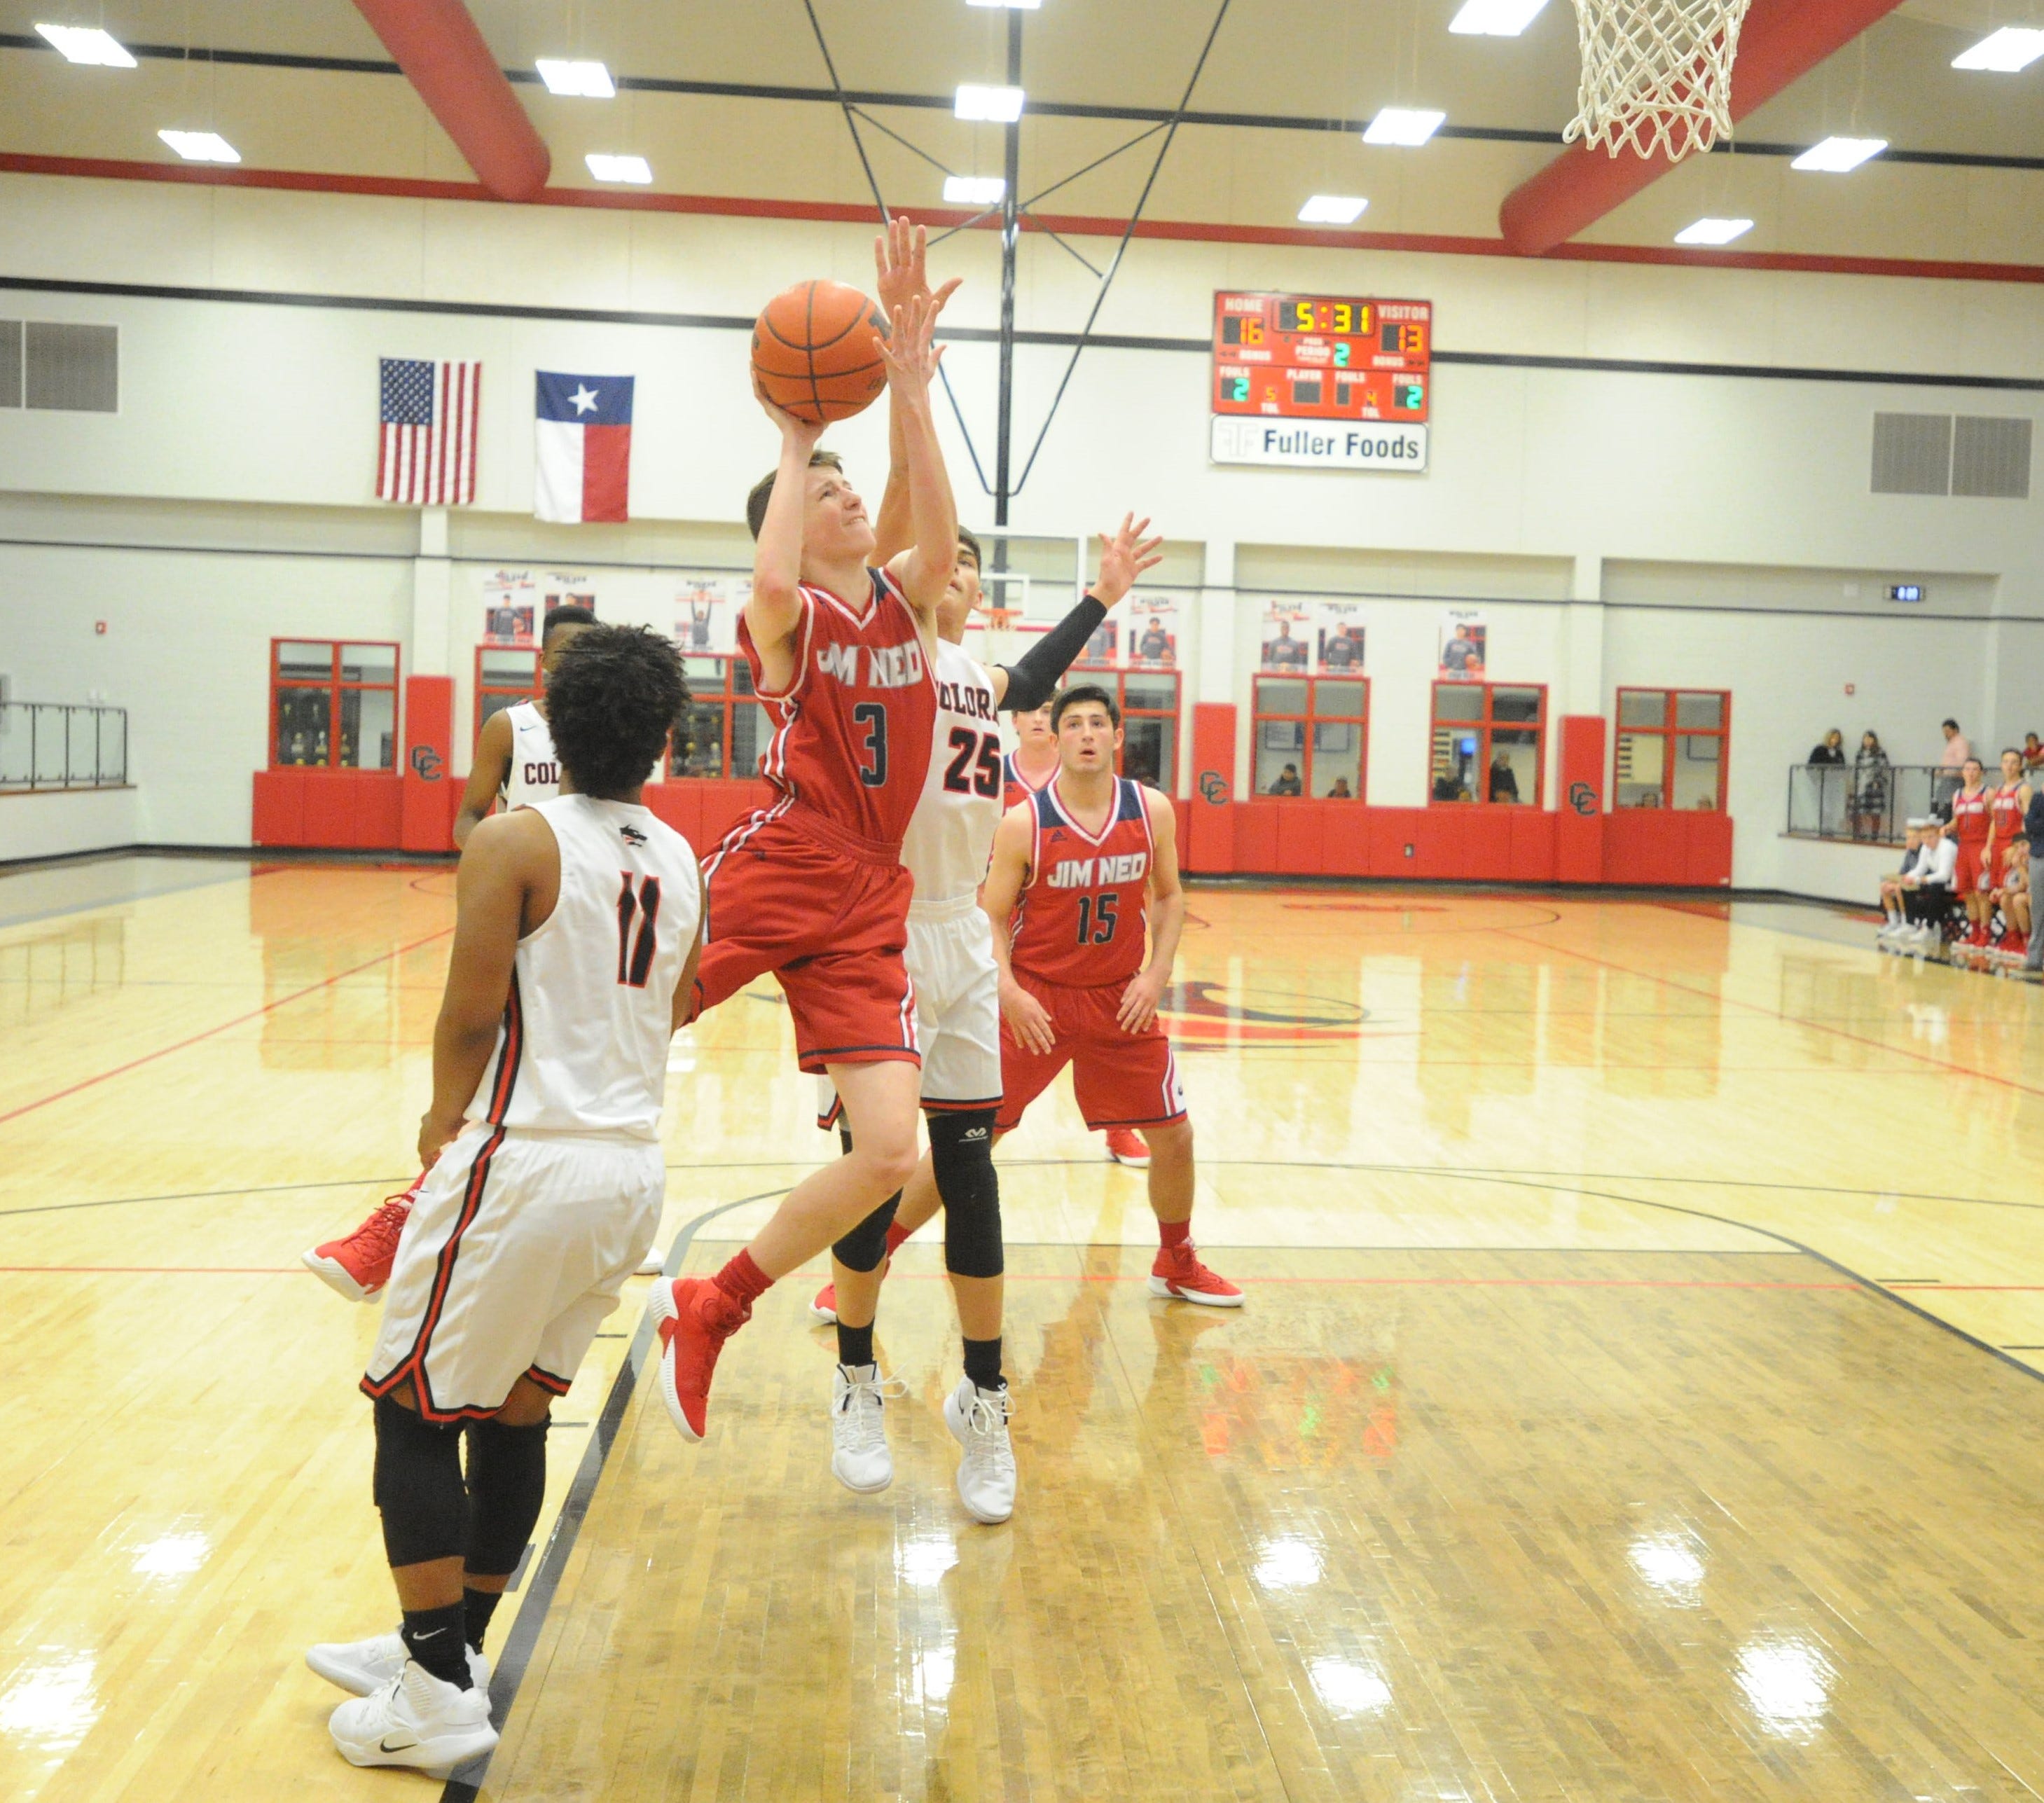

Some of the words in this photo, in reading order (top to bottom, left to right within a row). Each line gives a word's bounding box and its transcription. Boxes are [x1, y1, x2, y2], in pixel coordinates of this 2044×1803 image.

[1224, 298, 1264, 312] HOME
[1296, 301, 1370, 334] 5:31
[1378, 304, 1428, 321] VISITOR
[1241, 317, 1264, 345] 16
[1398, 324, 1423, 352] 13
[1333, 342, 1351, 368] 2
[1233, 376, 1250, 402] 2
[1406, 385, 1423, 410] 2
[1264, 429, 1336, 456] Fuller
[1346, 432, 1419, 460] Foods
[866, 638, 924, 689] NED
[852, 702, 890, 788] 3
[943, 725, 1002, 800] 25
[1047, 858, 1094, 890] JIM
[1097, 851, 1147, 887] NED
[616, 870, 661, 989] 11
[1077, 891, 1119, 946] 15
